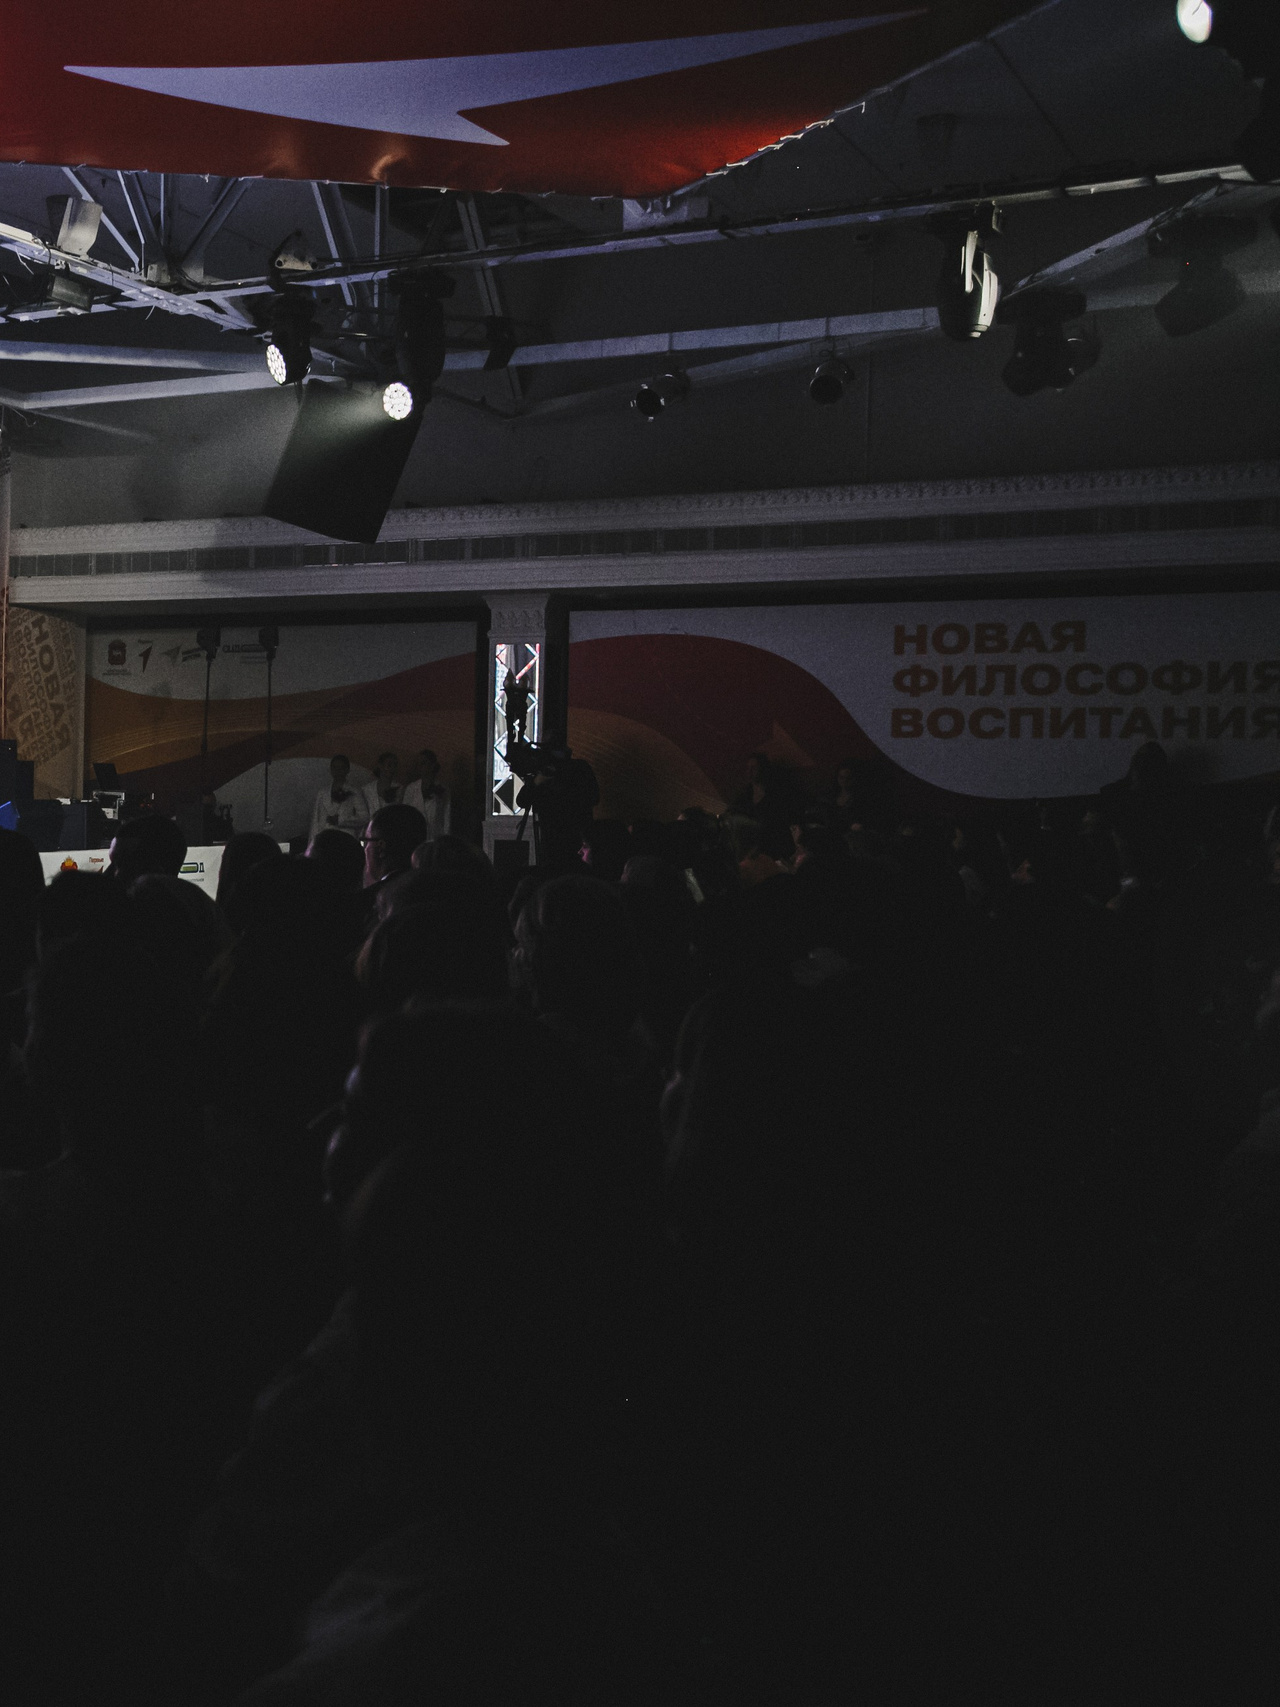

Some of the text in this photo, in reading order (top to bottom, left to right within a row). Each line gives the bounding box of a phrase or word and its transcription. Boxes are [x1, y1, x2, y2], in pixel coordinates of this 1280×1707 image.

[893, 621, 1087, 656] НОВАЯ
[892, 659, 1280, 697] ФИЛОСОФИЯ
[890, 705, 1280, 740] ВОСПИТАНИЯ
